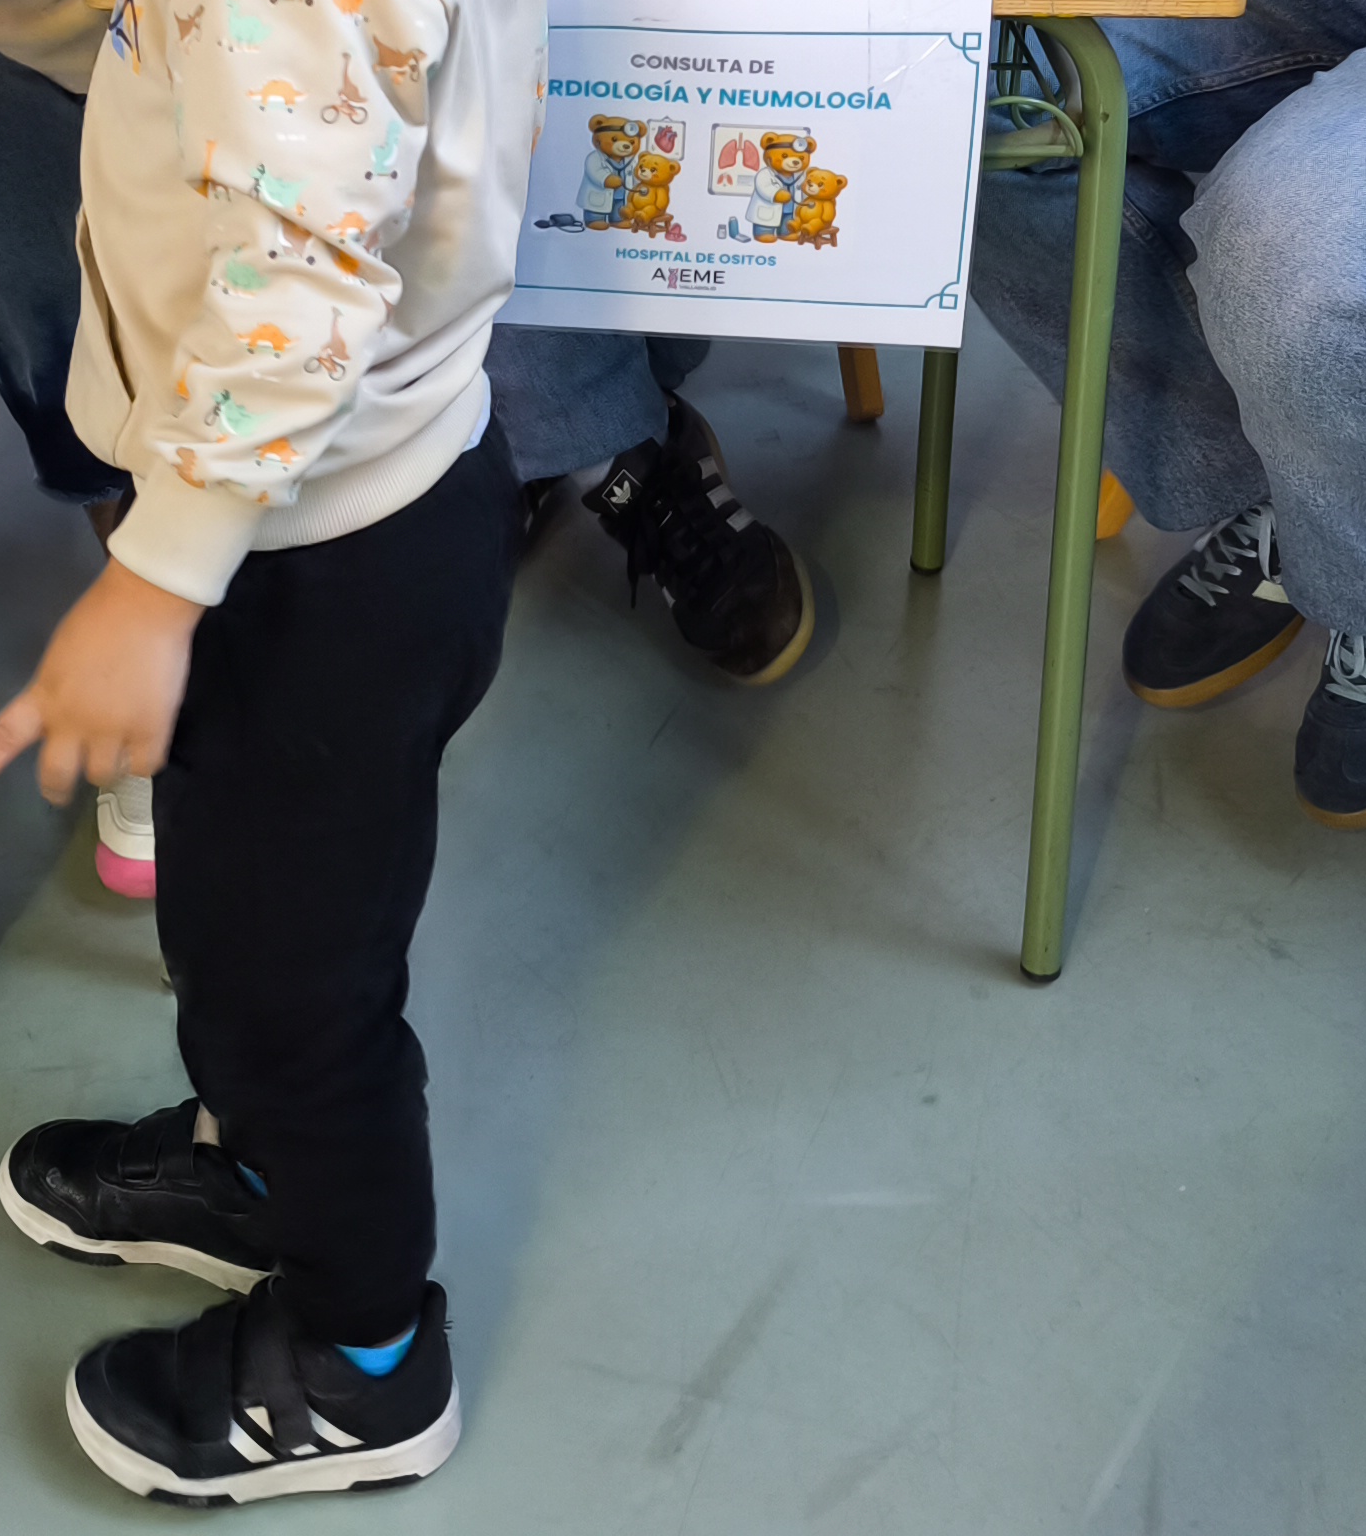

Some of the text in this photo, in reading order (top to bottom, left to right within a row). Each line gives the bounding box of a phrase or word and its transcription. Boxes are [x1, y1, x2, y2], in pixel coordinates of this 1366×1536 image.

[630, 53, 775, 75] CONSULTA DE
[548, 78, 892, 110] RDIOLOGÍA Y NEUMOLOGÍA
[615, 247, 777, 267] HOSPITAL DE OSITOS
